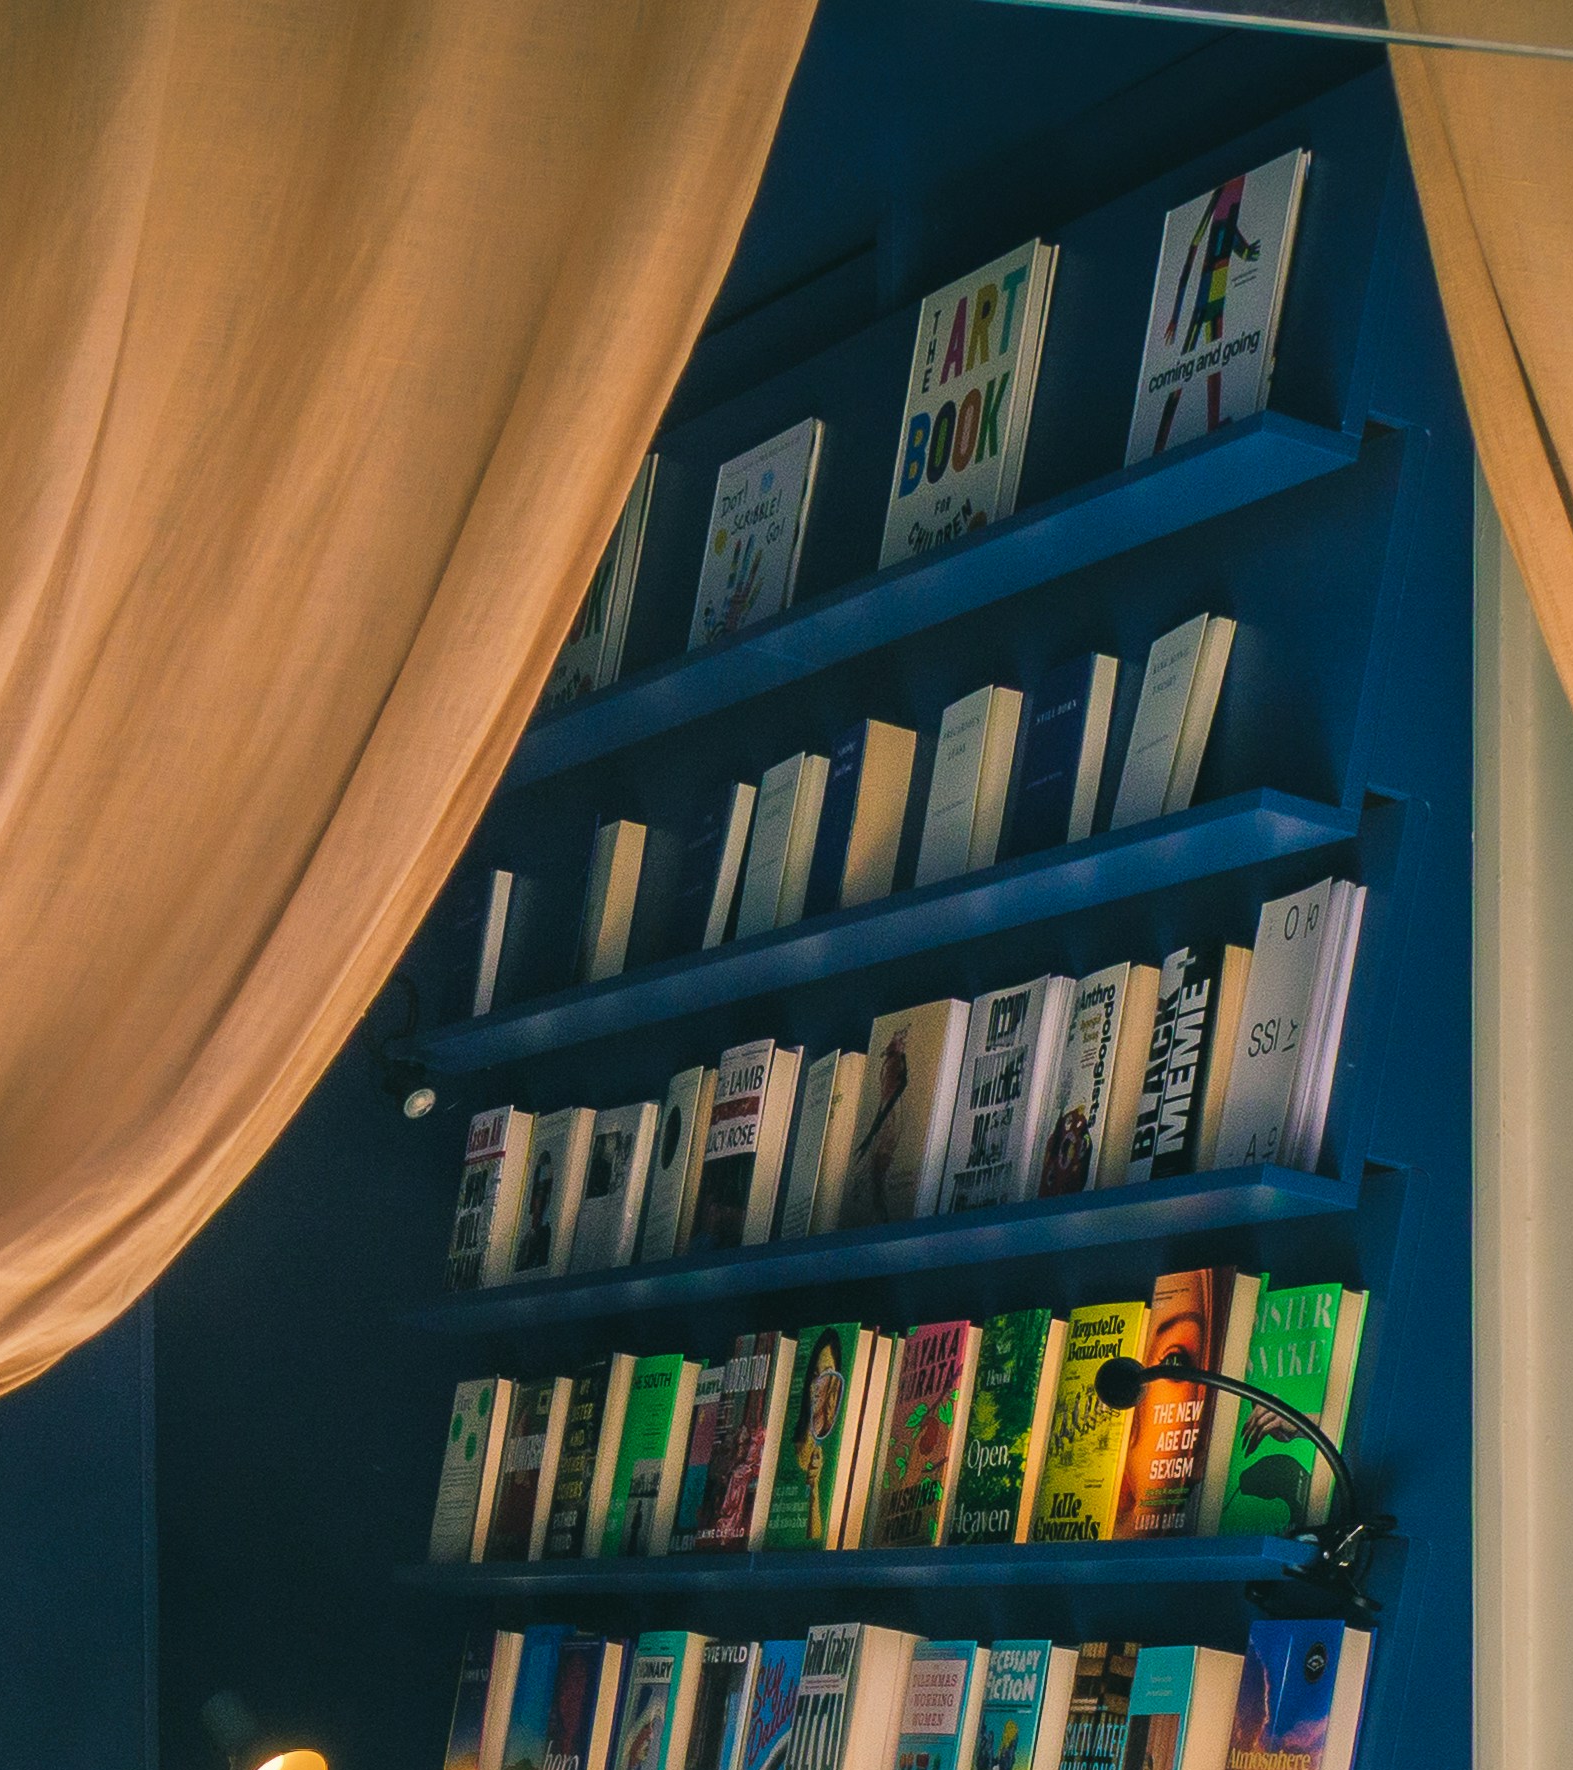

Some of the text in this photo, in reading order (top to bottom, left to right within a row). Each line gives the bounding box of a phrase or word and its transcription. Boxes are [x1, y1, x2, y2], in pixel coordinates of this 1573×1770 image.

[939, 263, 1029, 387] ART
[1148, 330, 1261, 393] coming and going
[898, 371, 1010, 499] BOOK
[934, 497, 951, 515] FOR
[729, 1064, 765, 1096] LAMB
[1131, 990, 1183, 1163] BLACK
[1155, 978, 1211, 1156] MEME
[1254, 1293, 1334, 1335] SISTER
[644, 1373, 674, 1391] SOUTH
[1154, 1400, 1204, 1425] THE NEW
[1156, 1428, 1200, 1452] AGE OF
[967, 1439, 1012, 1478] Open,
[1149, 1457, 1194, 1480] SEXISM
[1050, 1492, 1082, 1519] Idle
[1134, 1512, 1186, 1531] LAURA BATES
[952, 1508, 1011, 1540] Heaven
[1033, 1514, 1101, 1542] Grounds
